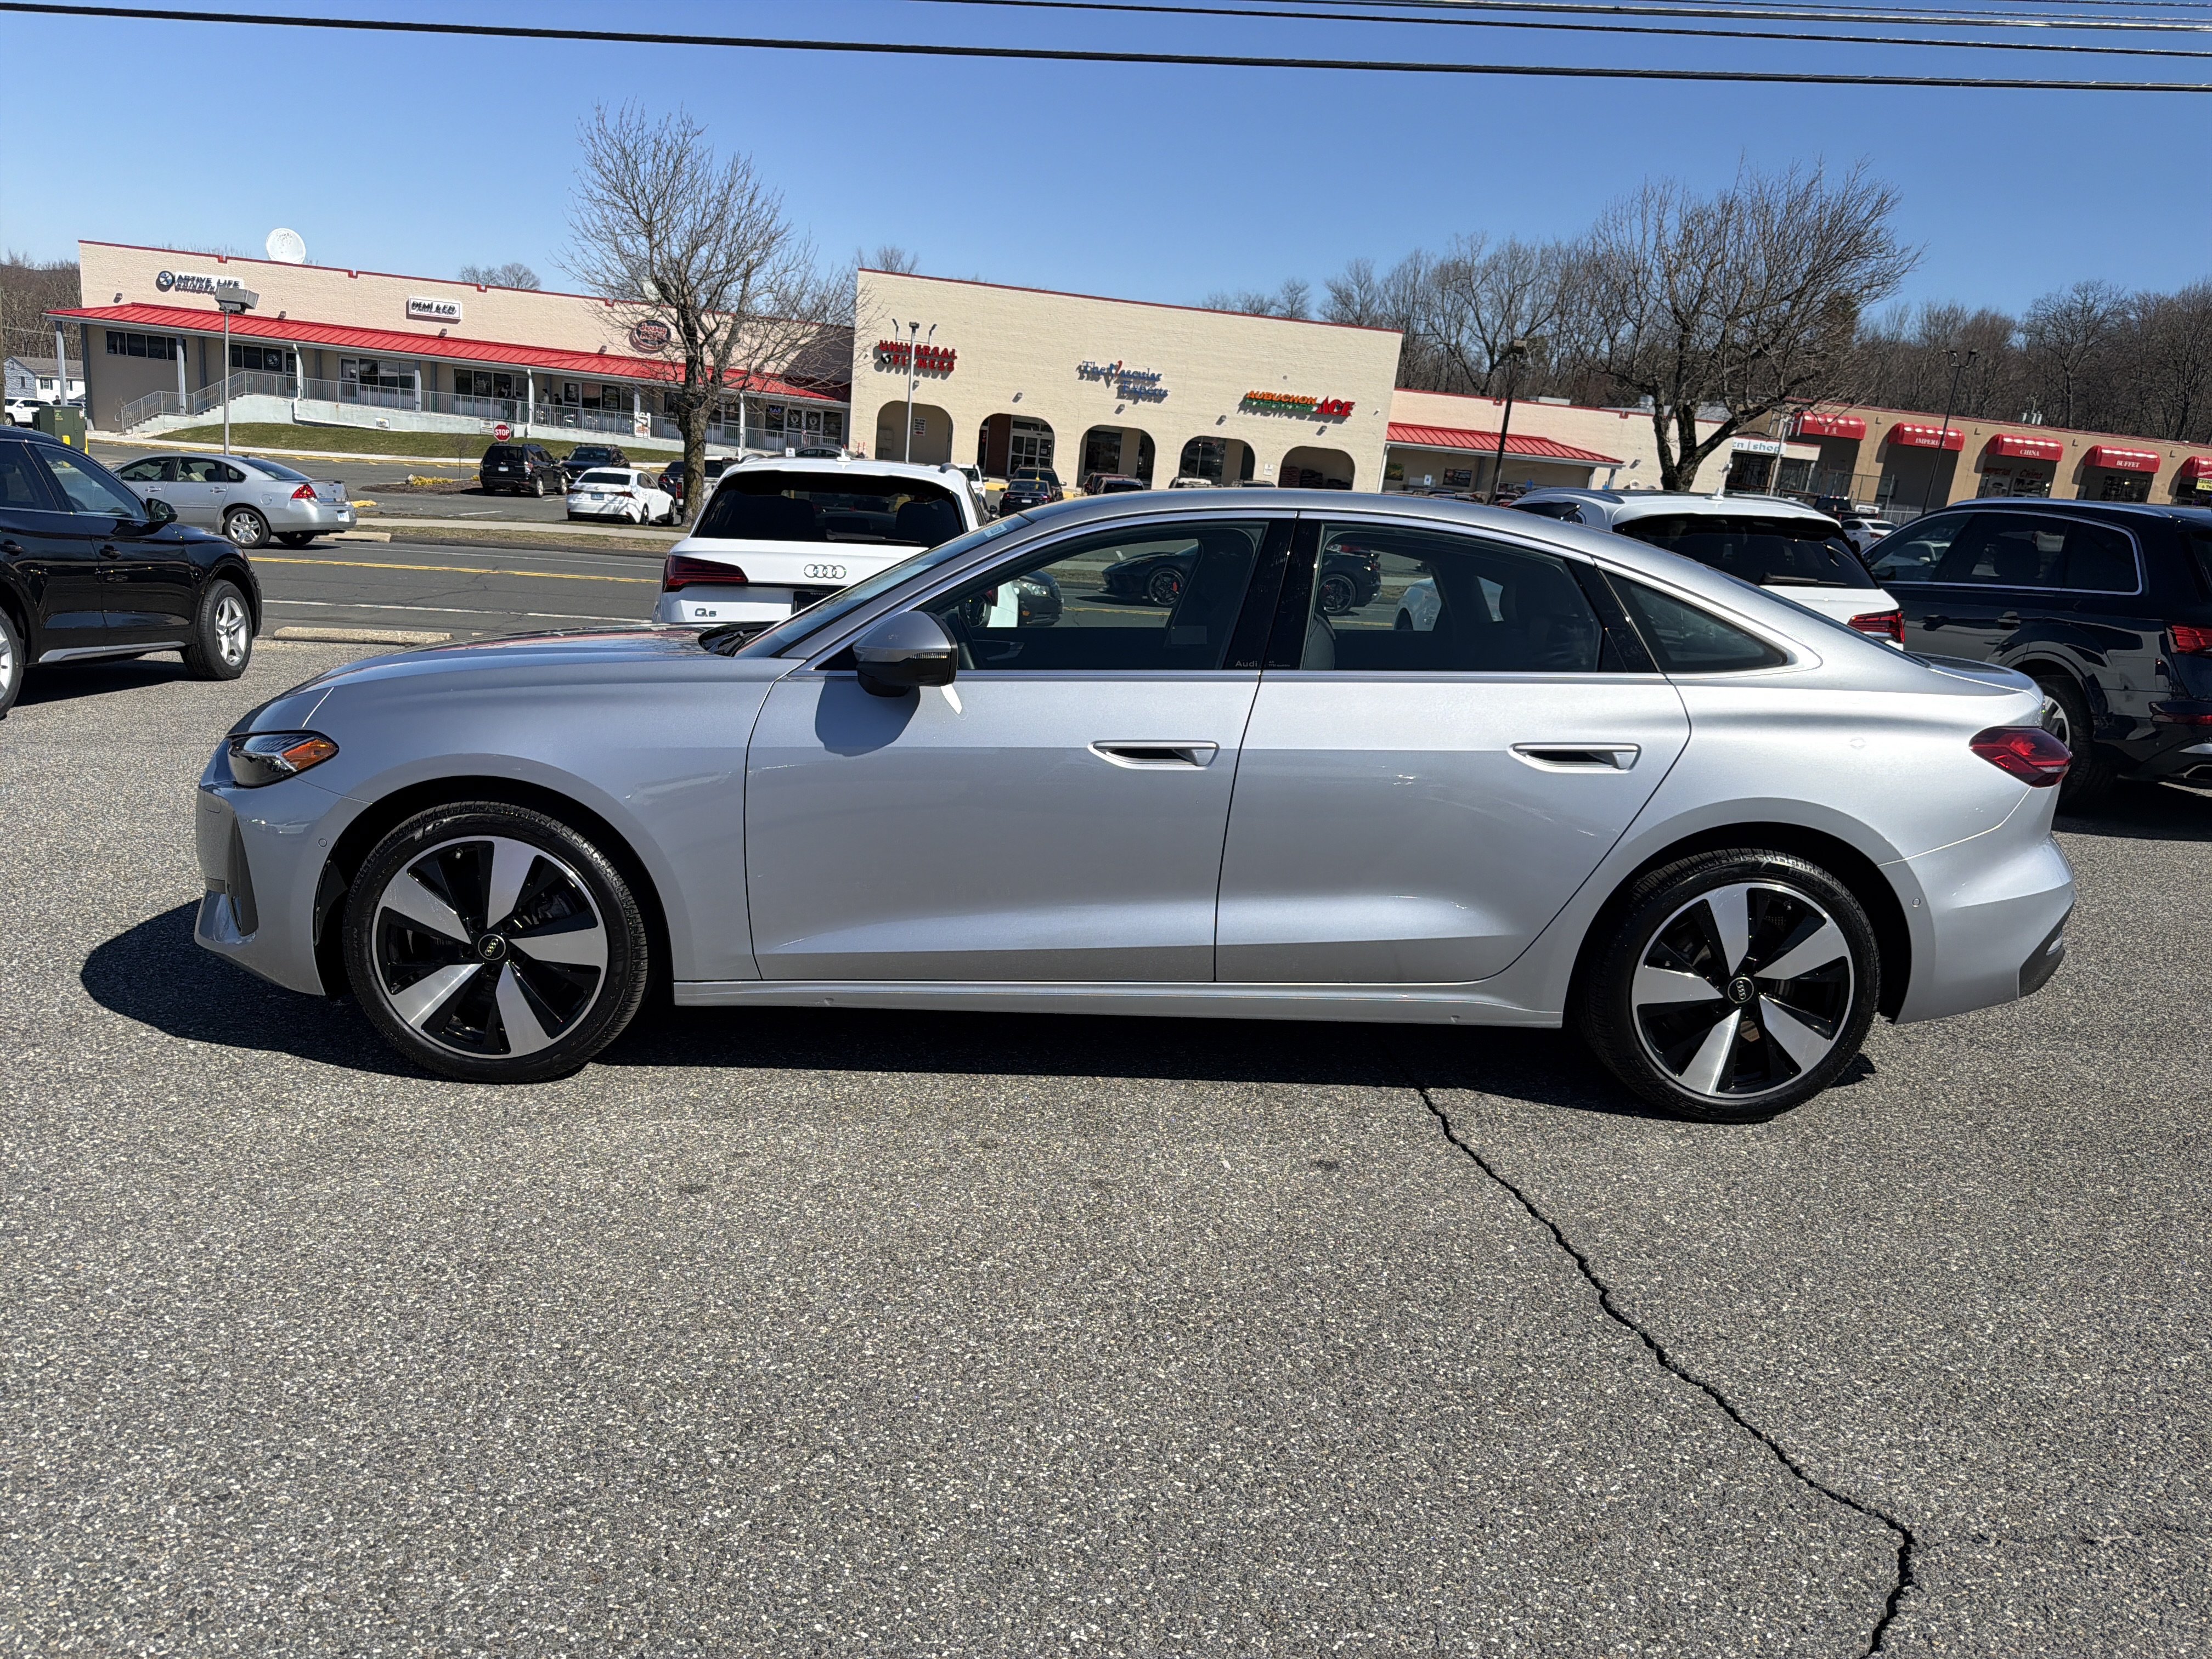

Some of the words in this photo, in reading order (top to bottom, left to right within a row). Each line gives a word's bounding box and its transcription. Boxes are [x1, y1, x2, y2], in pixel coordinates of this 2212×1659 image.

[177, 275, 212, 284] ACTIVE
[217, 279, 240, 287] LIFE
[641, 323, 666, 334] Jersey
[879, 340, 957, 360] UNIVERSAL
[893, 354, 954, 373] FINESS
[1082, 360, 1106, 375] The
[1108, 360, 1163, 381] Vascular
[1123, 380, 1169, 398] Experts
[1244, 398, 1316, 413] HARDWARE
[1246, 390, 1318, 405] AUBUCHON
[1315, 396, 1356, 417] ACE
[1915, 438, 1945, 447] IMPERIL
[695, 608, 717, 617] Q5
